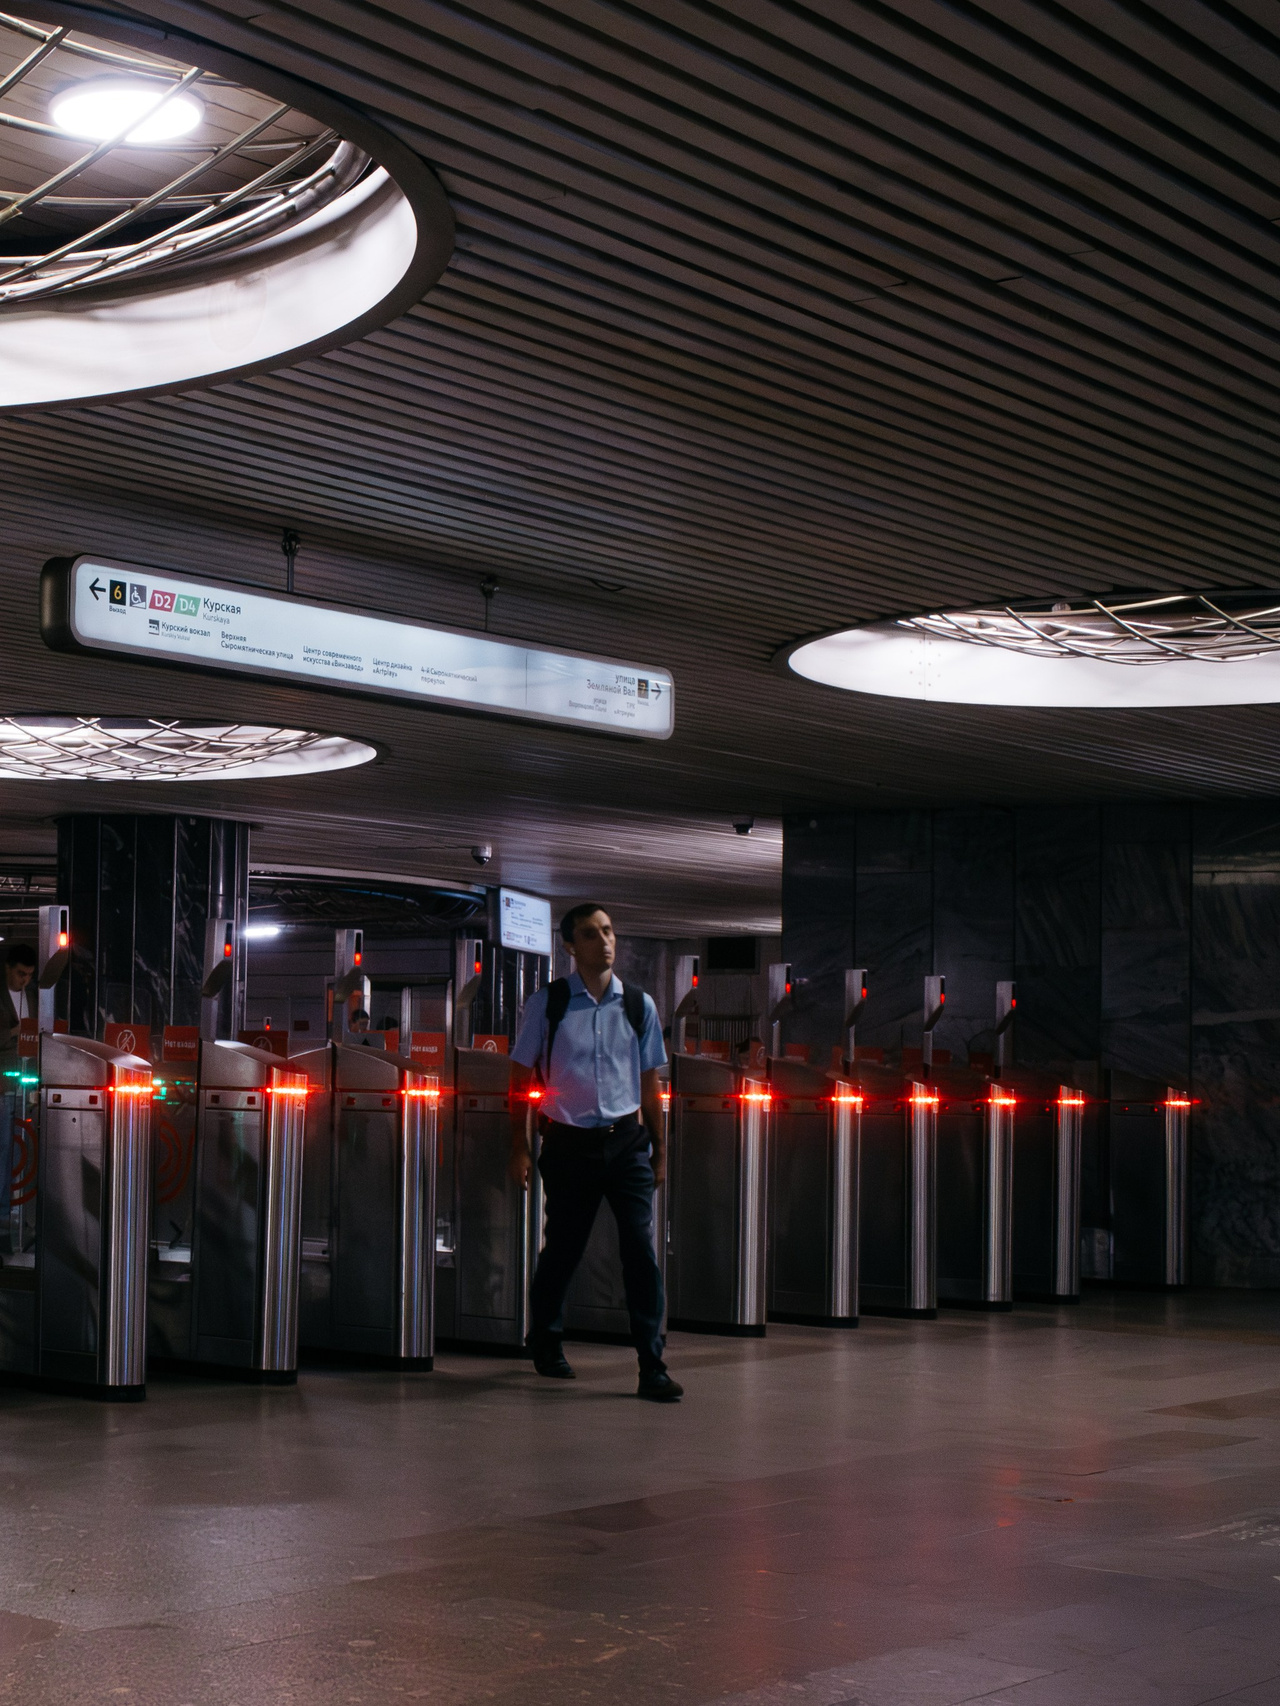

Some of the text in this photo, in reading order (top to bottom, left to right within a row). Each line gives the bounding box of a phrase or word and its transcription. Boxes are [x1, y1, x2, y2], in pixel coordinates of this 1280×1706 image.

[114, 585, 122, 600] 6
[109, 605, 126, 614] Выход
[154, 593, 196, 613] D2 D4
[203, 598, 241, 615] Курская
[203, 613, 230, 625] Kurskaya
[161, 621, 210, 637] Курский вокзал
[221, 631, 247, 642] Верхняя
[220, 640, 294, 660] Сыромятническая улица
[303, 645, 362, 662] Центр современного
[303, 655, 363, 672] искусства «Винзавод»
[373, 657, 412, 671] Центр дизайна
[615, 674, 635, 685] улица
[586, 679, 636, 696] Земляной Вал
[20, 1033, 34, 1042] Нет
